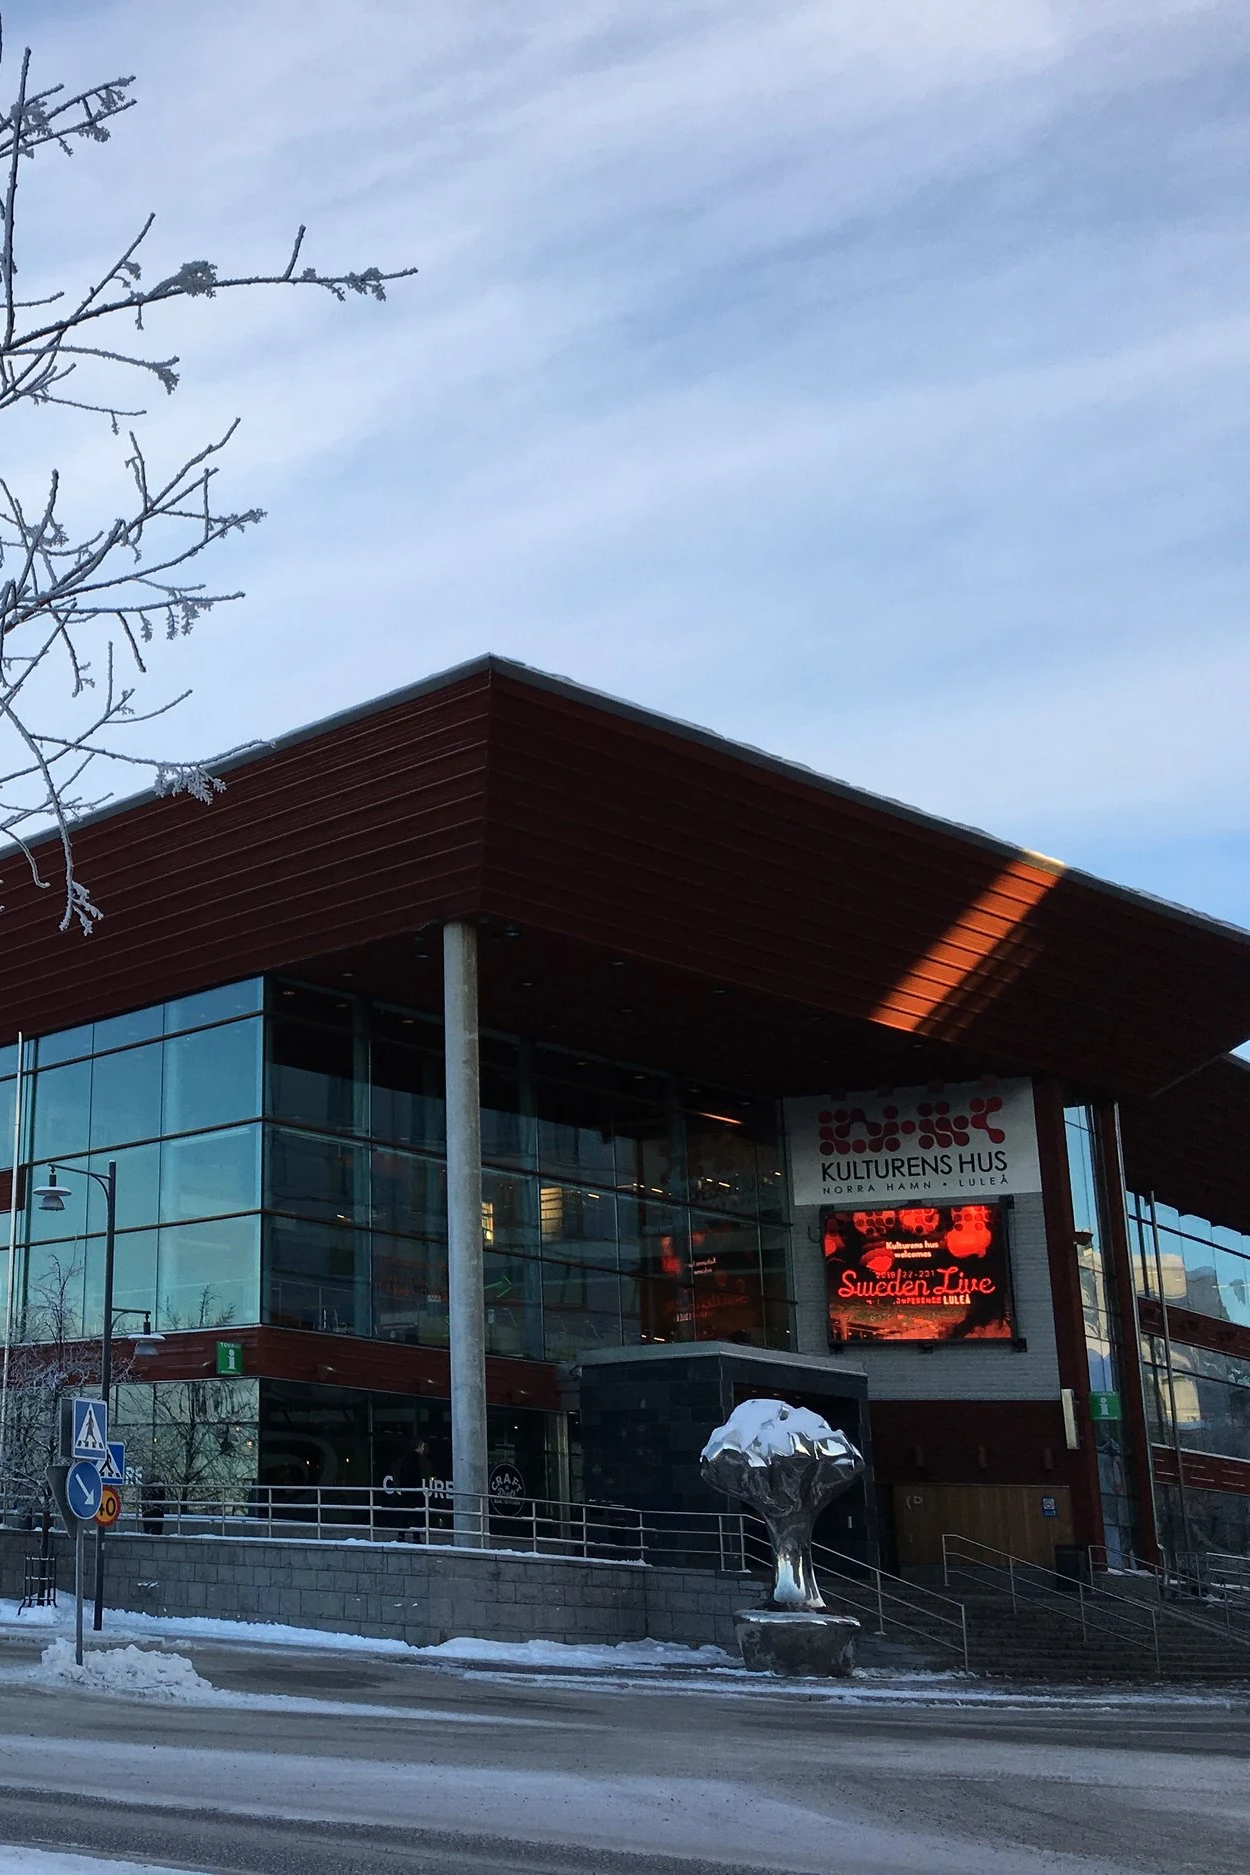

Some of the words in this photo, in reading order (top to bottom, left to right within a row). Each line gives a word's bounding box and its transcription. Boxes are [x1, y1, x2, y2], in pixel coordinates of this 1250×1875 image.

[821, 1154, 953, 1182] KULTURENS
[958, 1150, 1008, 1174] HUS
[822, 1184, 876, 1195] NORRA
[886, 1181, 932, 1191] HAMN
[958, 1174, 1009, 1187] LULEÅ
[885, 1241, 923, 1250] Kulturens
[924, 1240, 939, 1249] hus
[893, 1250, 932, 1258] welcomes
[838, 1268, 931, 1298] Sweden
[933, 1266, 996, 1294] Live
[491, 1473, 523, 1492] CRAFT
